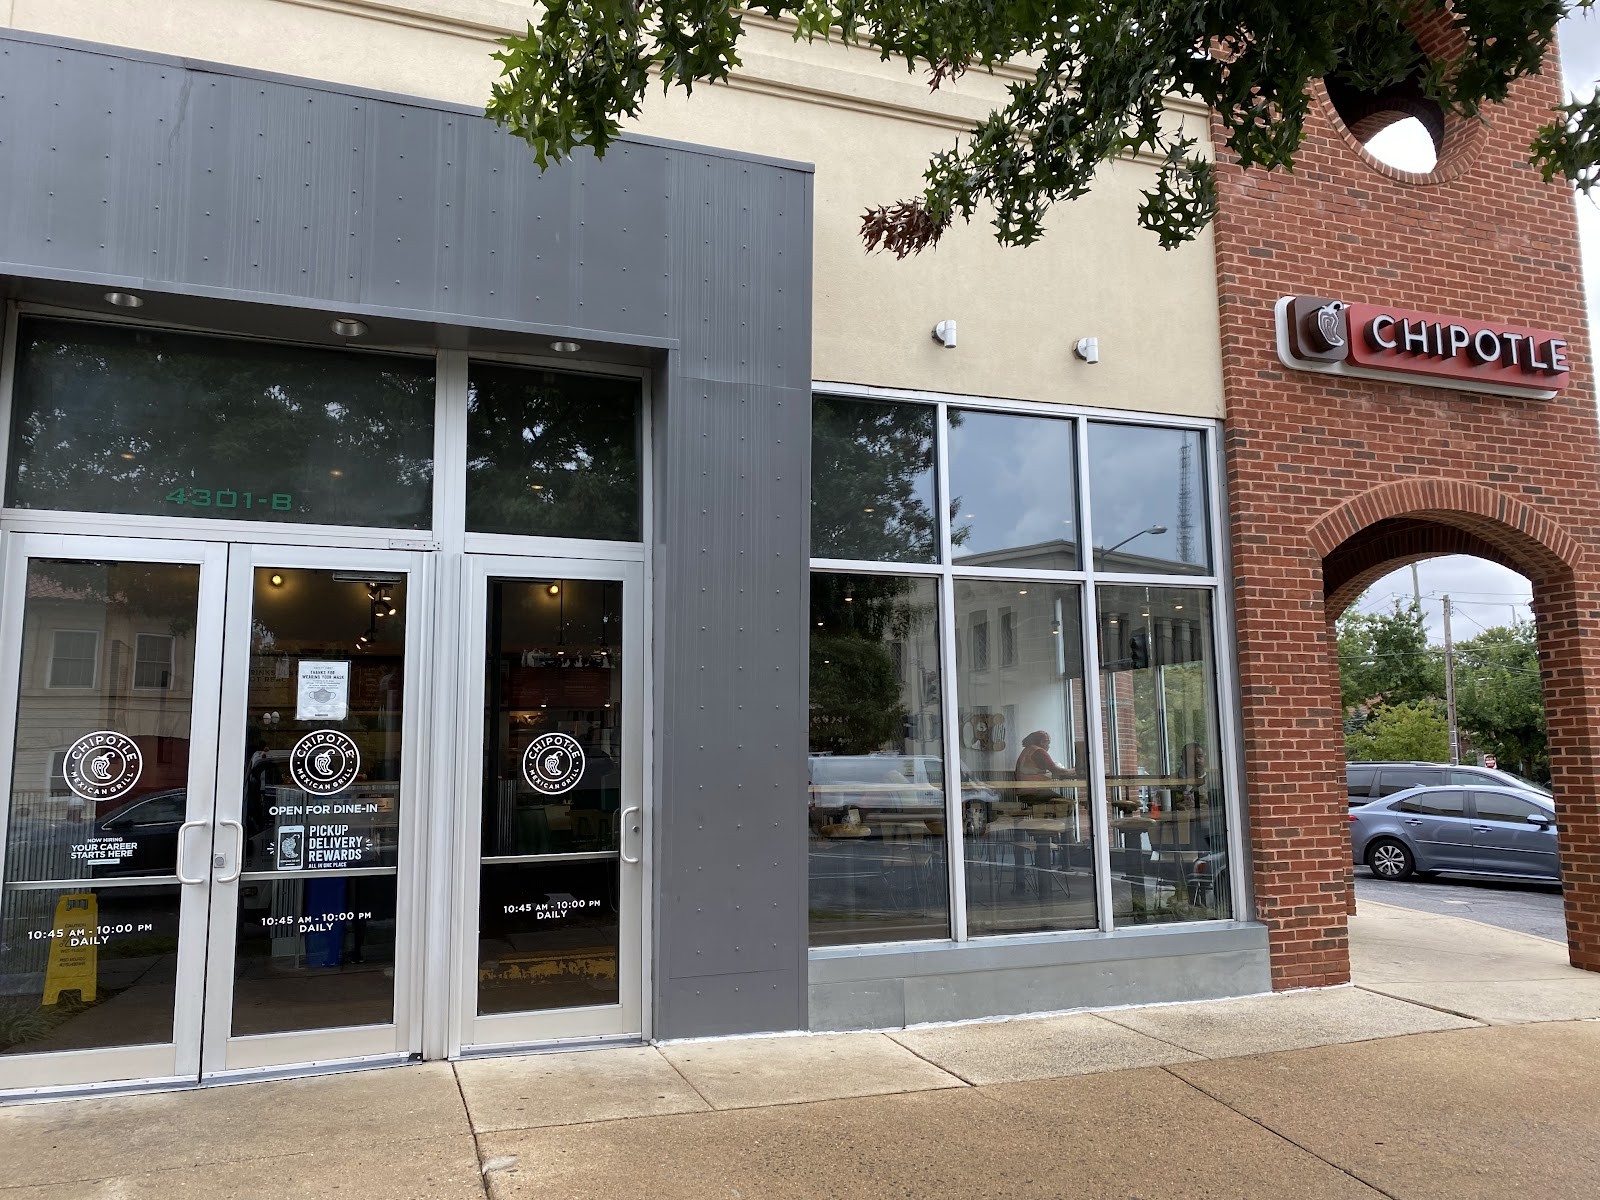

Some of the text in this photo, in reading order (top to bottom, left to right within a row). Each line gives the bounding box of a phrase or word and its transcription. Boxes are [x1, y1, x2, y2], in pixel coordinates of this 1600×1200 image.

[1371, 313, 1571, 374] CHIPOTLE
[165, 487, 292, 511] 4301-B
[71, 735, 138, 762] CHIPOTLE
[296, 733, 355, 759] CHIPOTLE
[528, 736, 580, 759] CHIPOTLE
[71, 771, 135, 795] MEXICAN GRILL
[297, 768, 353, 790] MEXICAN GRILL
[529, 768, 580, 790] MEXICAN GRILL
[269, 804, 378, 816] OPEN FOR DINE-IN
[309, 824, 349, 837] PICKUP
[71, 842, 138, 852] YOUR CAREER
[309, 836, 363, 850] DELIVERY
[70, 849, 133, 859] STARTS HERE
[308, 849, 362, 862] REWARDS
[503, 903, 532, 914] 10:45
[535, 903, 548, 911] AM
[556, 900, 585, 910] 10:00
[261, 916, 294, 926] 10:45
[297, 916, 312, 924] AM
[321, 912, 354, 922] 10:00
[536, 910, 568, 920] DAILY
[27, 928, 64, 940] 10:45
[69, 929, 85, 937] AM
[96, 923, 133, 935] 10:00
[138, 923, 153, 932] PM
[299, 922, 334, 933] DAILY
[70, 935, 110, 947] DAILY
